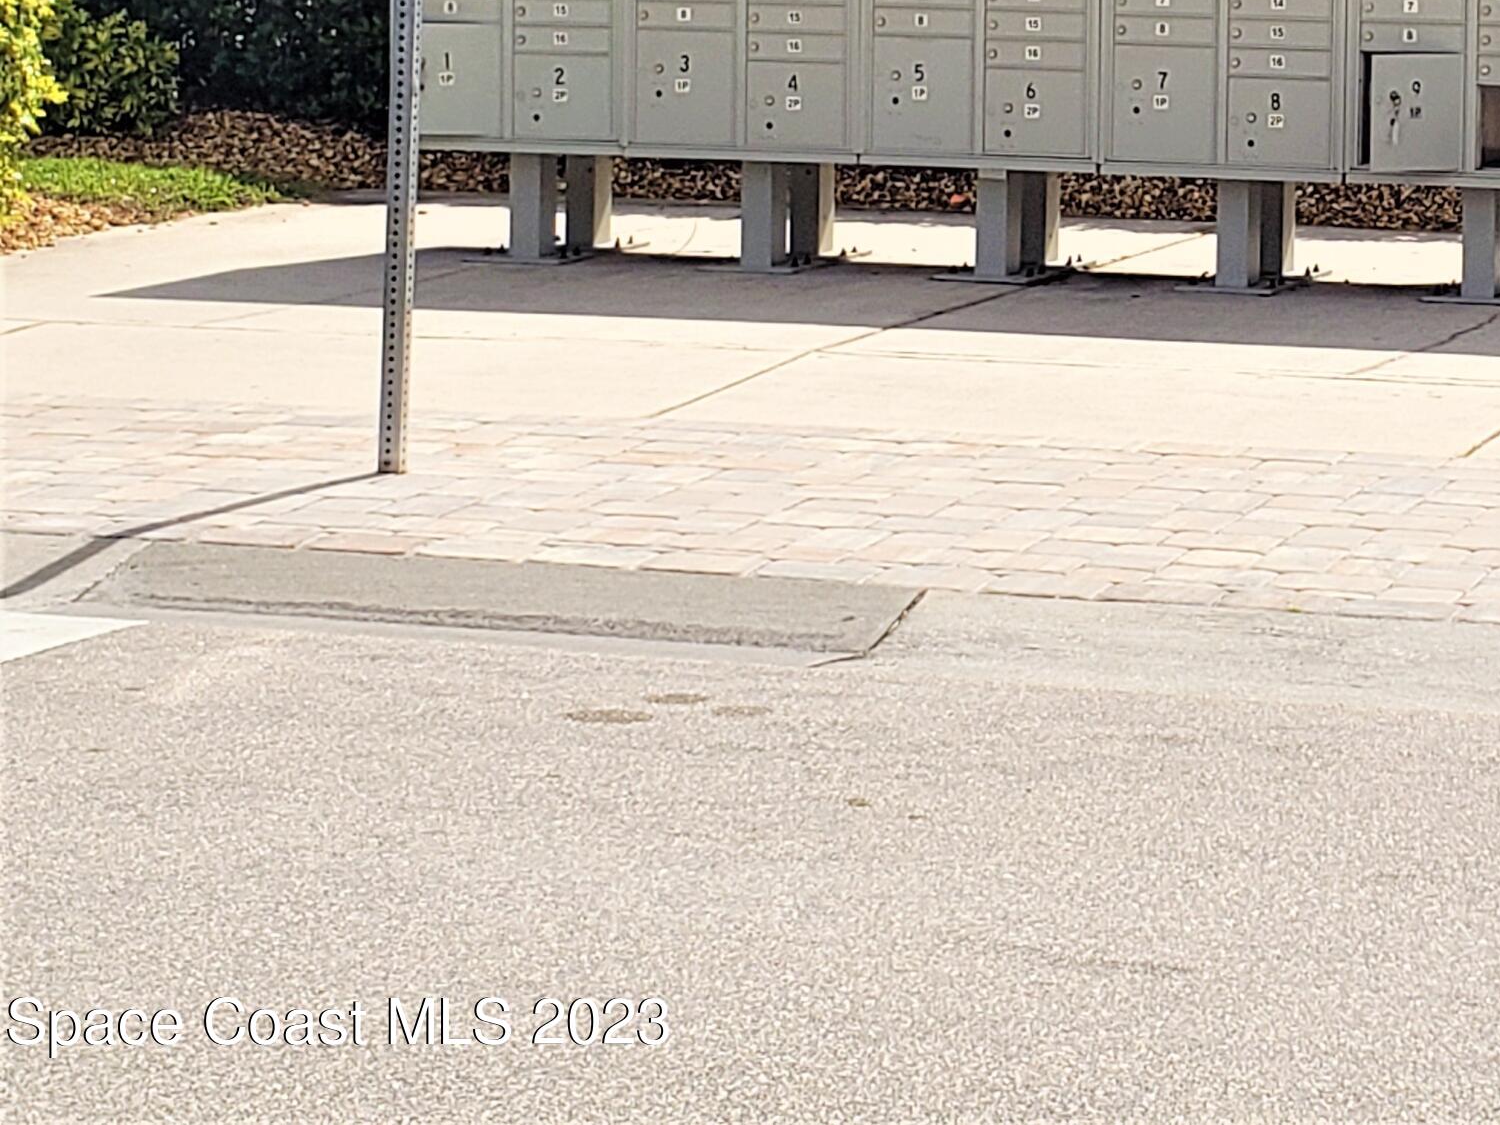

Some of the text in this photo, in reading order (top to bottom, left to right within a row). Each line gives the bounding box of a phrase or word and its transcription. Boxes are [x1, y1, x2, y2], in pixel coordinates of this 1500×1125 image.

[789, 12, 800, 22] 15
[1028, 19, 1039, 29] 15
[1272, 27, 1284, 37] 15
[444, 52, 450, 71] 1
[679, 54, 690, 73] 3
[1272, 57, 1283, 67] 16
[554, 67, 565, 86] 2
[914, 63, 925, 82] 5
[440, 74, 454, 83] 1P
[788, 74, 798, 92] 4
[1158, 71, 1168, 90] 7
[677, 80, 689, 90] 1P
[554, 90, 568, 100] 2P
[913, 87, 927, 98] 1P
[1026, 82, 1036, 100] 6
[787, 97, 801, 108] 2P
[1155, 97, 1167, 107] 1P
[1271, 92, 1281, 111] 8
[1026, 106, 1040, 116] 2P
[1270, 115, 1284, 126] 2P
